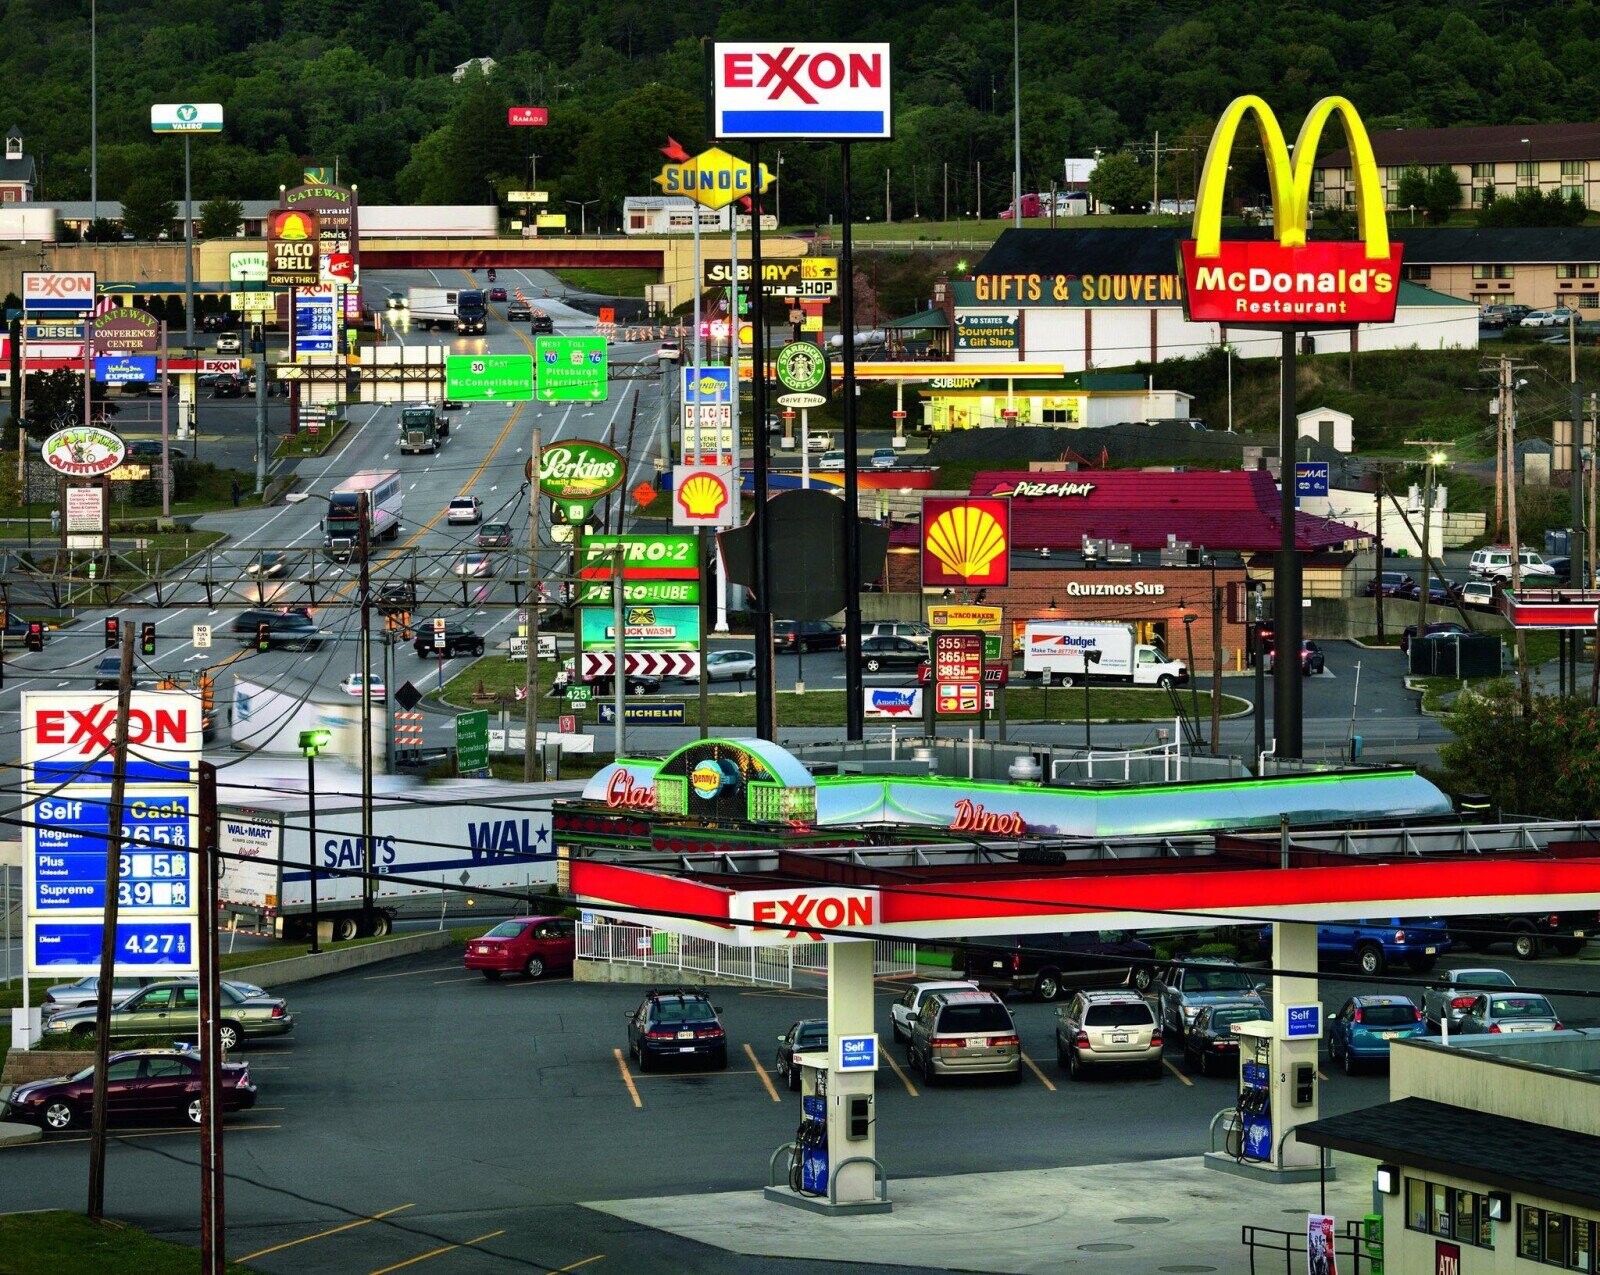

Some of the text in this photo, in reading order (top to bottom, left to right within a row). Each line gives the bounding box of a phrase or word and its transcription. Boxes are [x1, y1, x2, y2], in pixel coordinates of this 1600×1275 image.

[724, 47, 882, 104] EXXON
[513, 115, 543, 123] RAMADA
[172, 122, 203, 130] VALERO
[666, 168, 763, 190] SUNOC
[287, 188, 350, 203] GATEWAY
[333, 217, 349, 225] SHOP
[274, 244, 314, 256] TACO
[275, 257, 313, 269] BELL
[331, 261, 350, 272] KFC
[26, 274, 91, 297] EXXON
[271, 276, 316, 284] DRIVE THRU
[1195, 267, 1392, 293] McDonald's
[975, 274, 1042, 300] GIFTS
[1053, 274, 1069, 301] &
[1236, 298, 1347, 313] Restaurant
[95, 308, 155, 328] GATEWAY
[36, 327, 81, 338] DIESEL
[95, 329, 155, 338] CONFERENCE
[958, 326, 1015, 336] Souvenirs
[107, 340, 143, 348] CENTER
[958, 337, 1014, 349] & Gift Shop
[545, 354, 601, 362] 70 76
[779, 344, 823, 364] STARBUCKS
[206, 361, 237, 372] EXXON
[472, 363, 484, 372] 30
[546, 368, 598, 377] Pittsburgh
[546, 378, 599, 388] Harrisburg
[785, 377, 818, 389] COFFEE
[931, 377, 980, 389] SUBWAY
[781, 396, 824, 404] DRIVE THRU
[687, 408, 706, 418] DLI
[49, 453, 118, 473] OUTFITTERS
[540, 448, 616, 479] Perkins
[1303, 469, 1327, 478] MAC
[588, 584, 687, 600] PERO:LUBE
[612, 627, 672, 636] TUCK WASH
[938, 638, 960, 649] 355
[1063, 635, 1096, 648] Budget
[938, 652, 960, 662] 365
[938, 665, 960, 676] 385
[566, 690, 587, 700] 425
[36, 703, 187, 758] EXXON
[692, 773, 718, 786] Denny's
[39, 801, 185, 820] Self Cash
[949, 799, 1026, 835] Diner
[324, 818, 537, 868] SAM'S WAL
[39, 856, 64, 867] Plus
[40, 884, 94, 898] Supreme
[753, 894, 873, 941] EXXON
[39, 936, 61, 944] Diesel
[1290, 1010, 1310, 1020] Self
[844, 1041, 865, 1052] Self
[1280, 1073, 1286, 1083] 3
[1439, 1254, 1459, 1275] ATM
